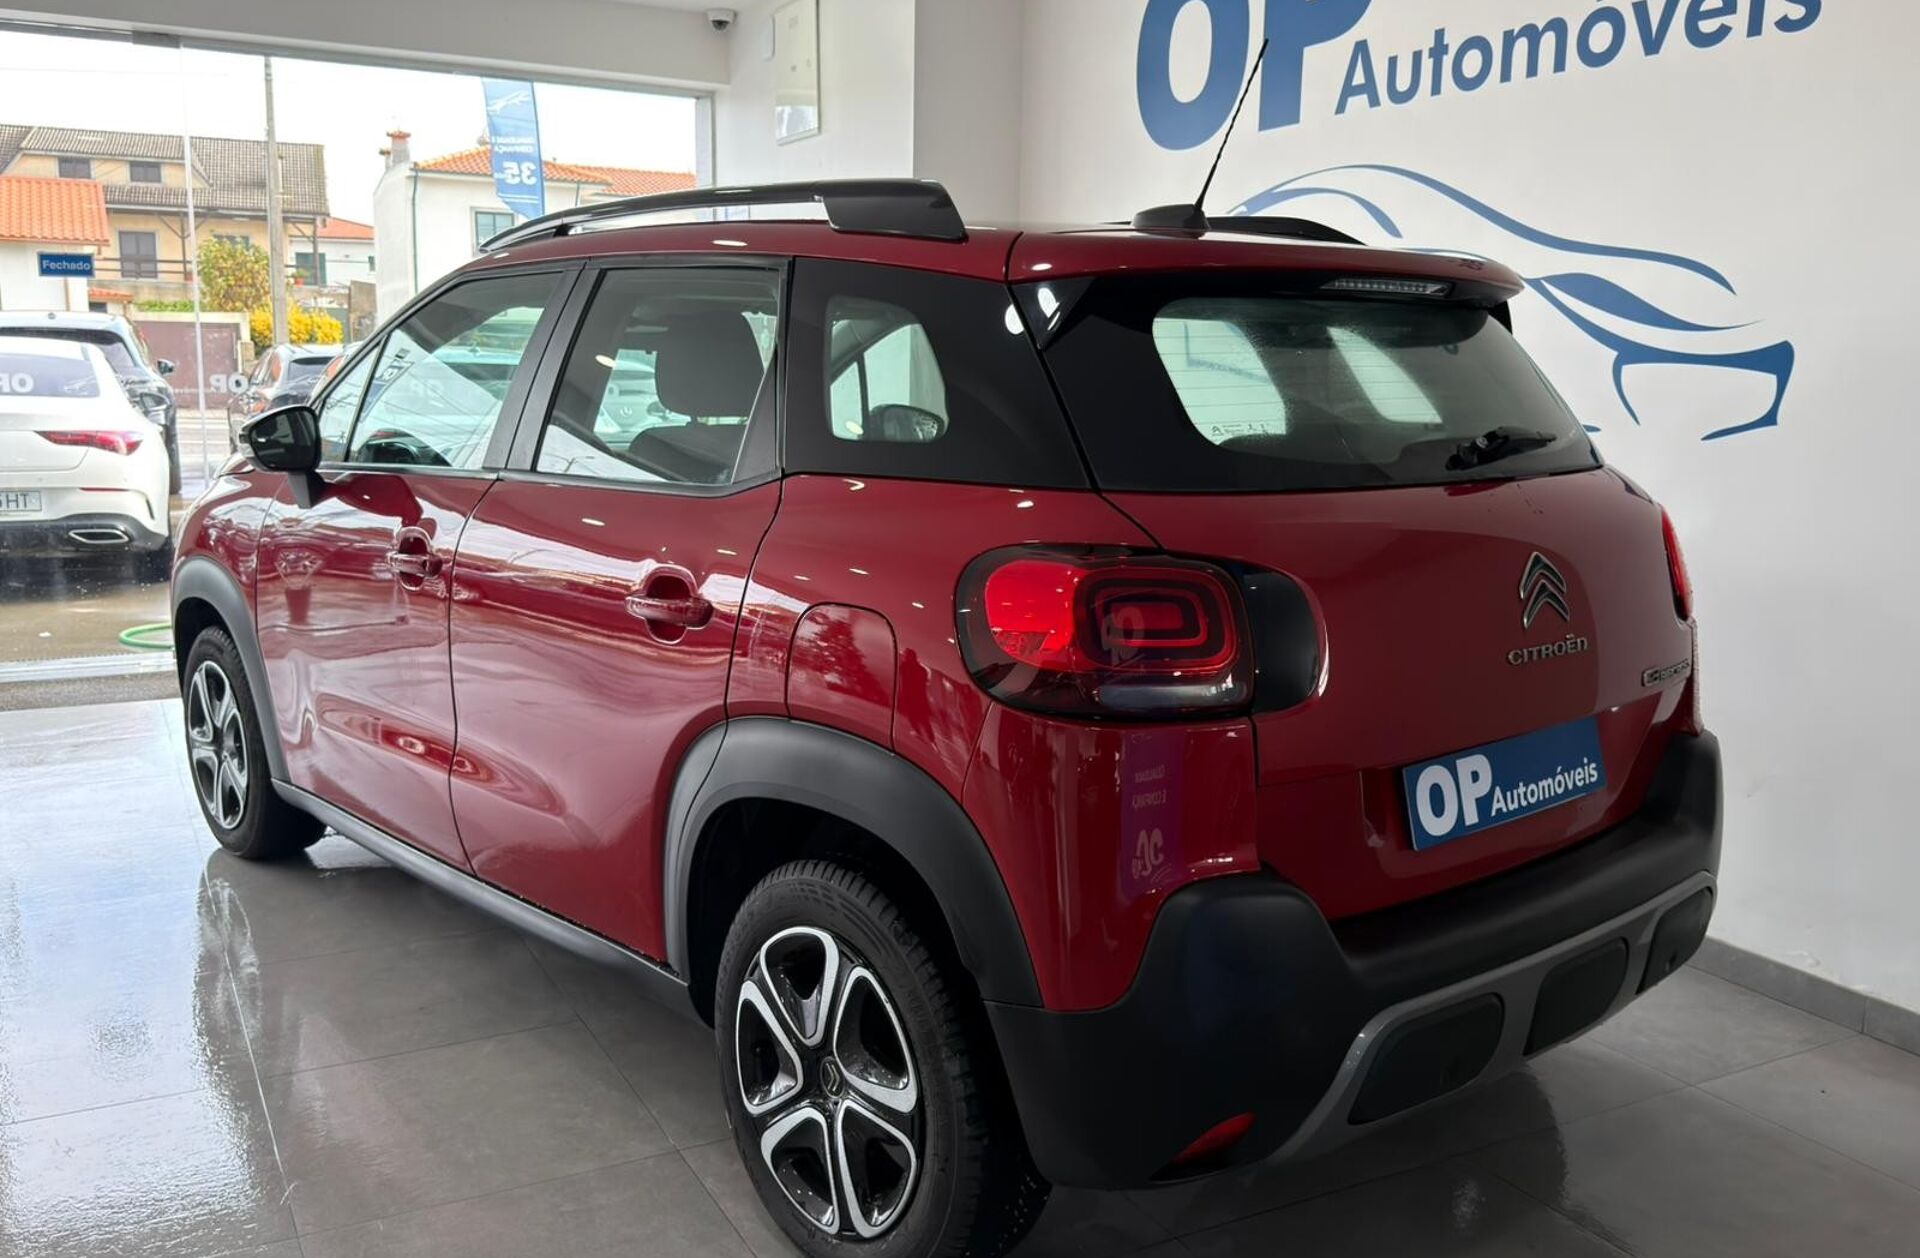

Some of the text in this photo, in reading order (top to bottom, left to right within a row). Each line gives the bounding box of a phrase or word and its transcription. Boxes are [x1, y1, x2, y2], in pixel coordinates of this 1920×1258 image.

[42, 260, 91, 270] Fechado
[0, 492, 29, 509] HT
[1416, 754, 1598, 836] OP Automóveis
